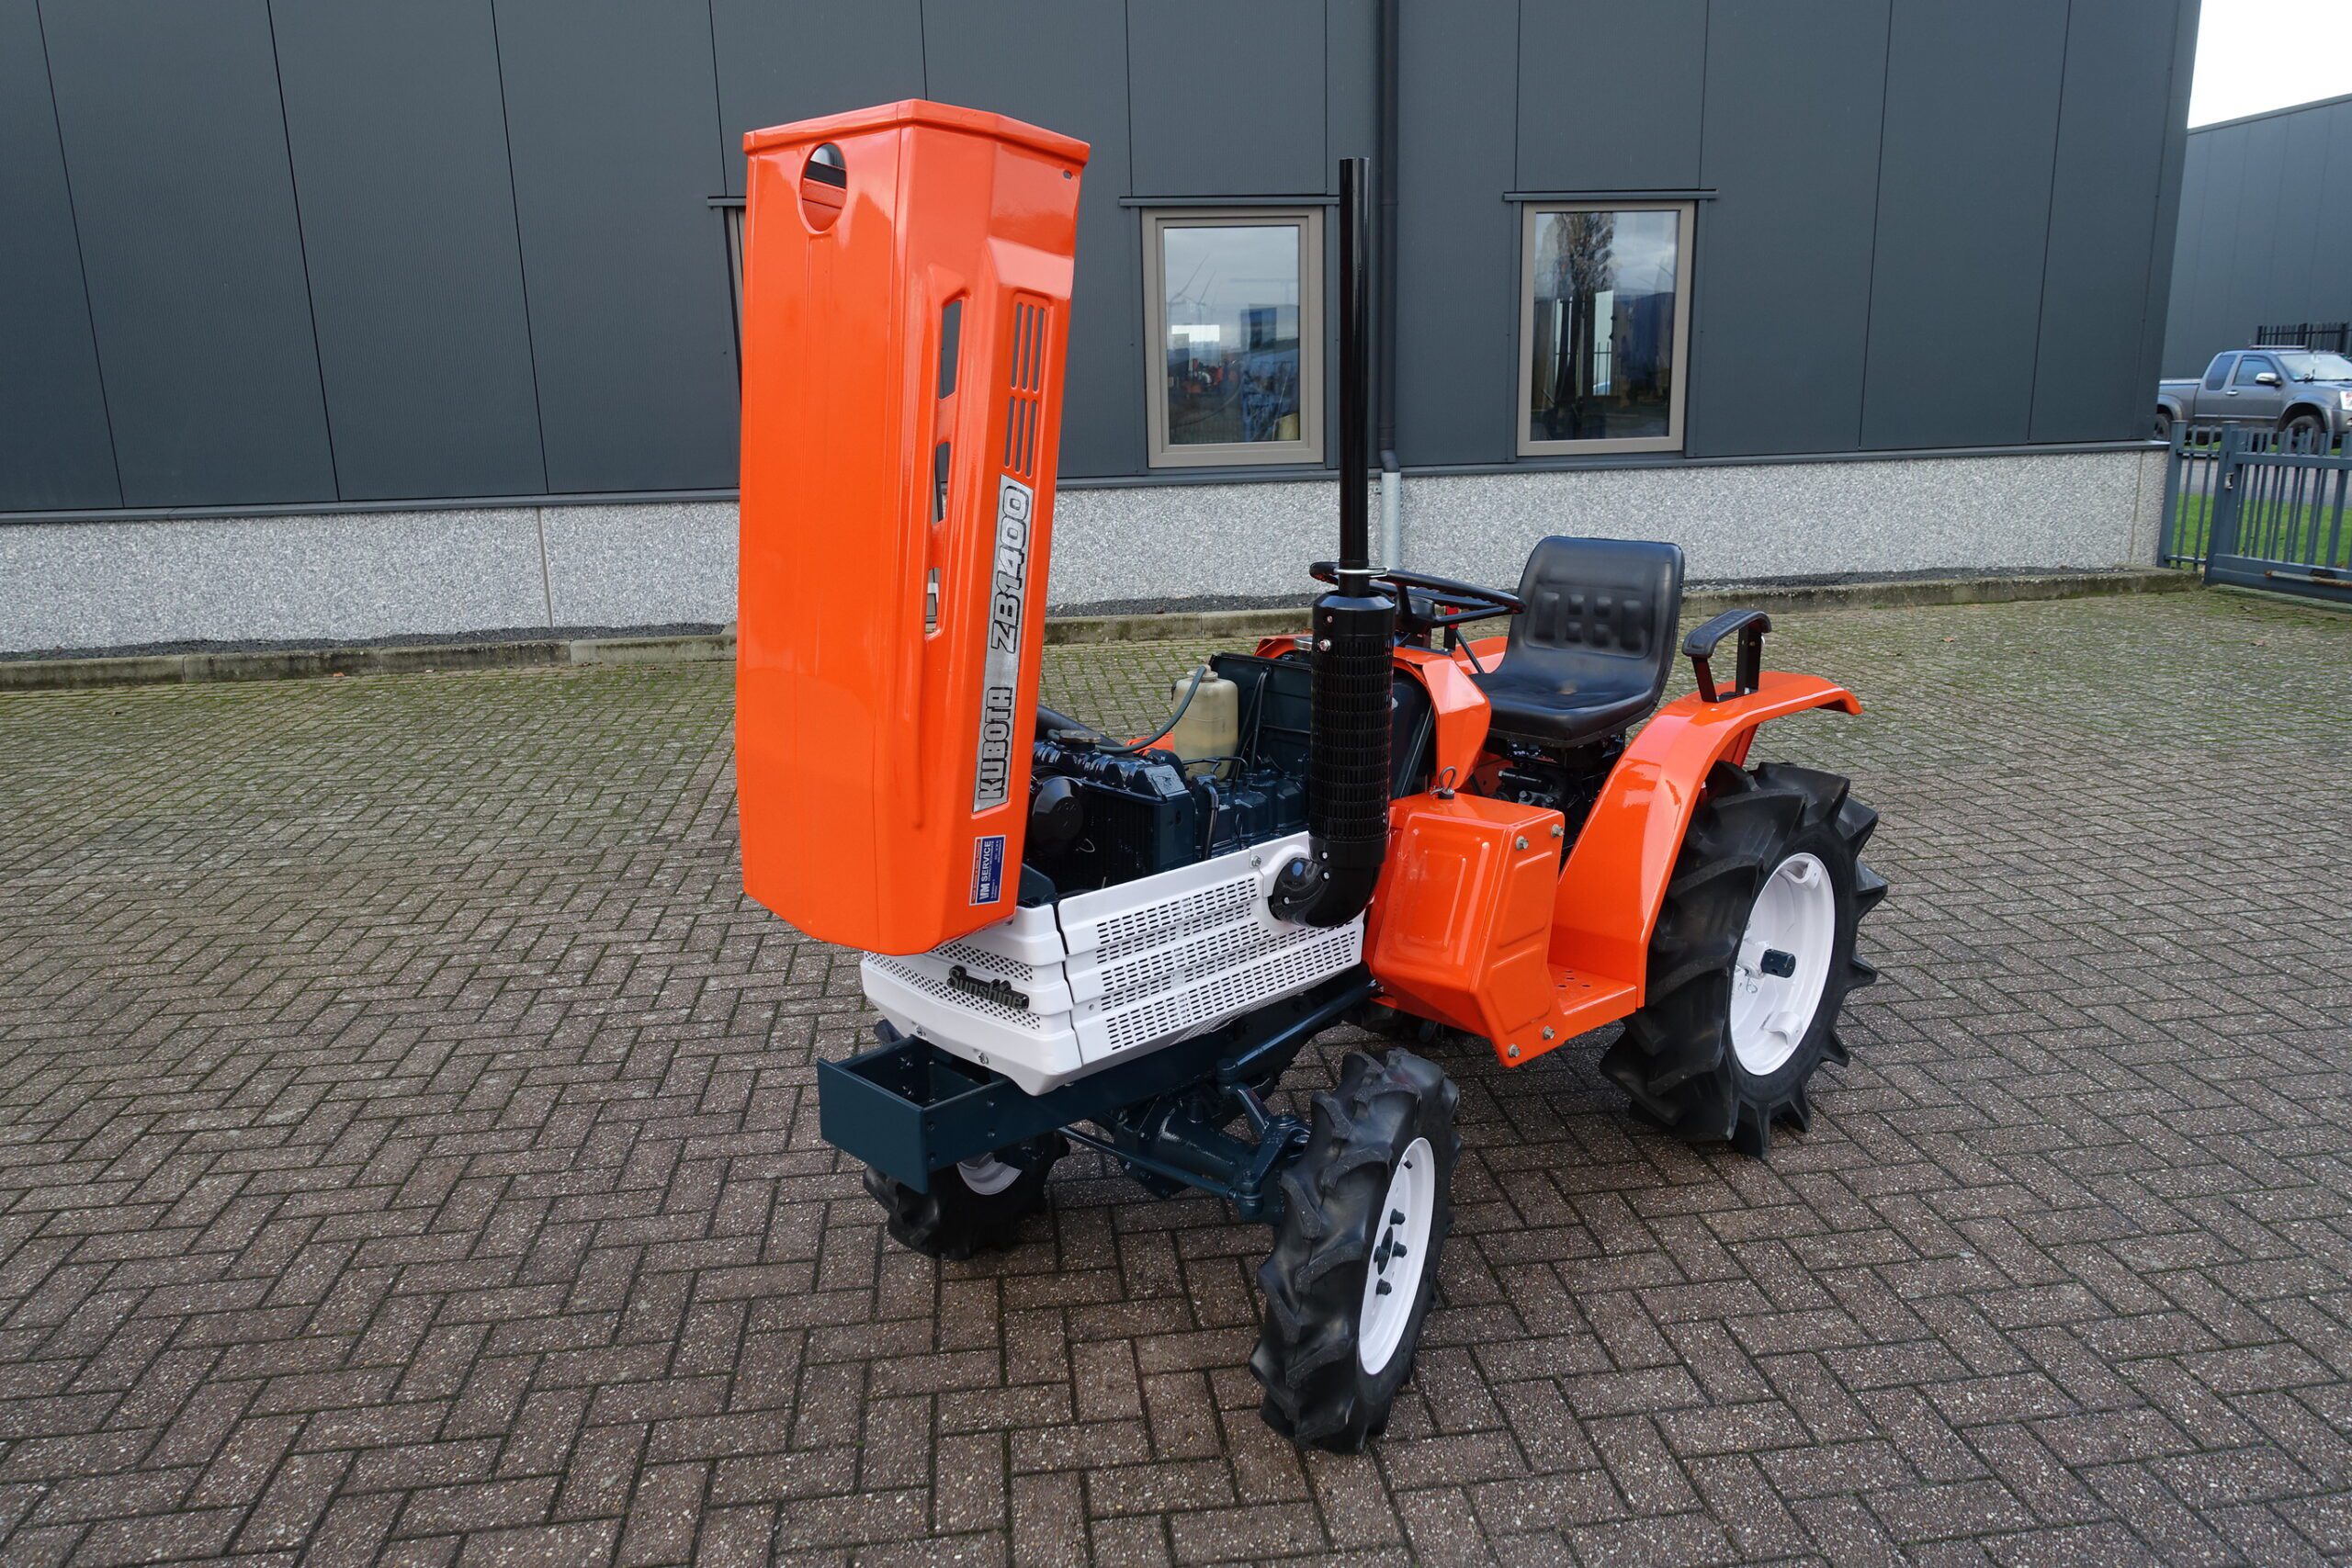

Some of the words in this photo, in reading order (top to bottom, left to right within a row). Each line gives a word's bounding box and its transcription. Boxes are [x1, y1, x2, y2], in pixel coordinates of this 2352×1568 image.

[990, 485, 1029, 654] ZB1400
[978, 687, 1012, 800] KUBOTA
[981, 840, 990, 882] SERVICE
[947, 966, 1026, 1010] Sunshine
